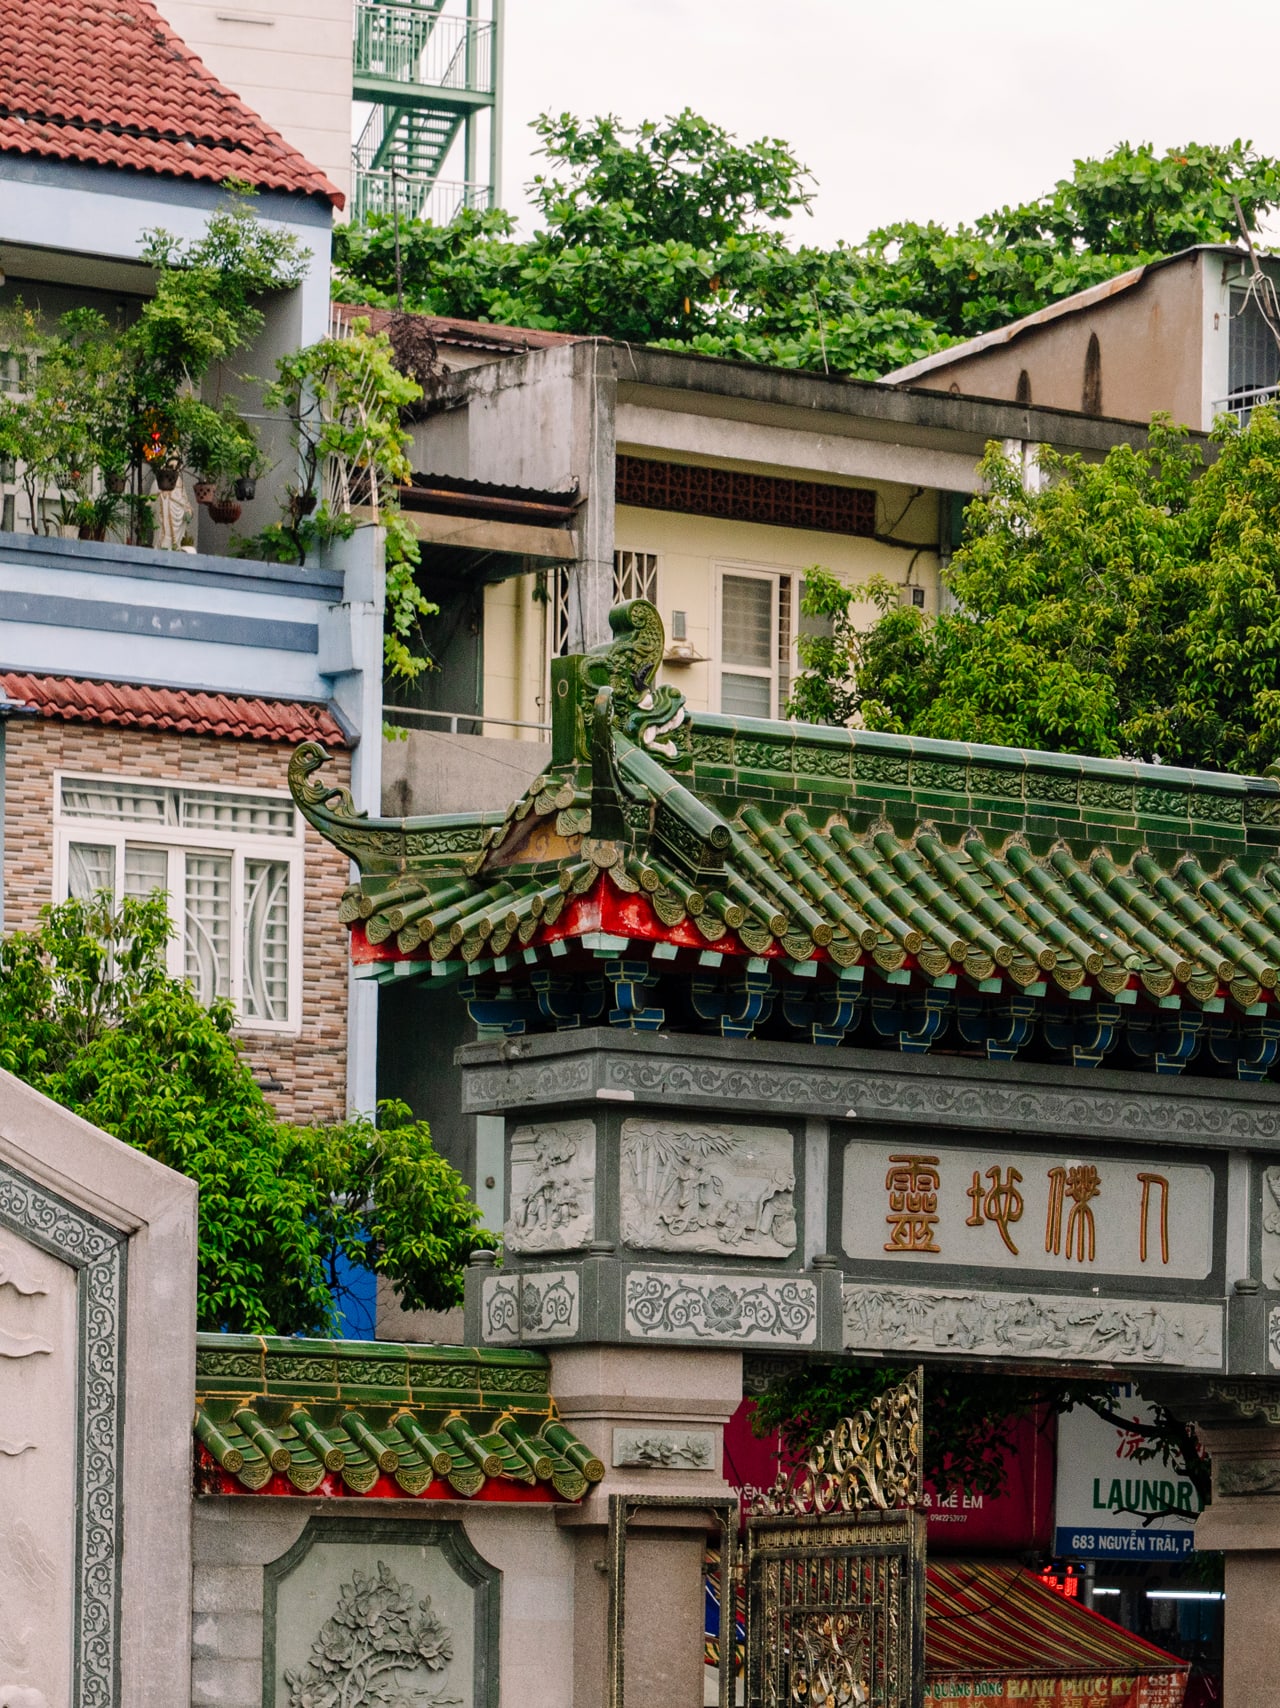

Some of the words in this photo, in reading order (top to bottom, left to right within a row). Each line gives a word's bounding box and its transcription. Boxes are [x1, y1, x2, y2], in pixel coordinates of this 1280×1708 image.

[962, 1494, 983, 1509] EM
[1071, 1535, 1095, 1550] 683
[1098, 1529, 1145, 1551] NGUYỄN
[1148, 1534, 1180, 1554] TRÃI,
[1148, 1673, 1181, 1687] 681
